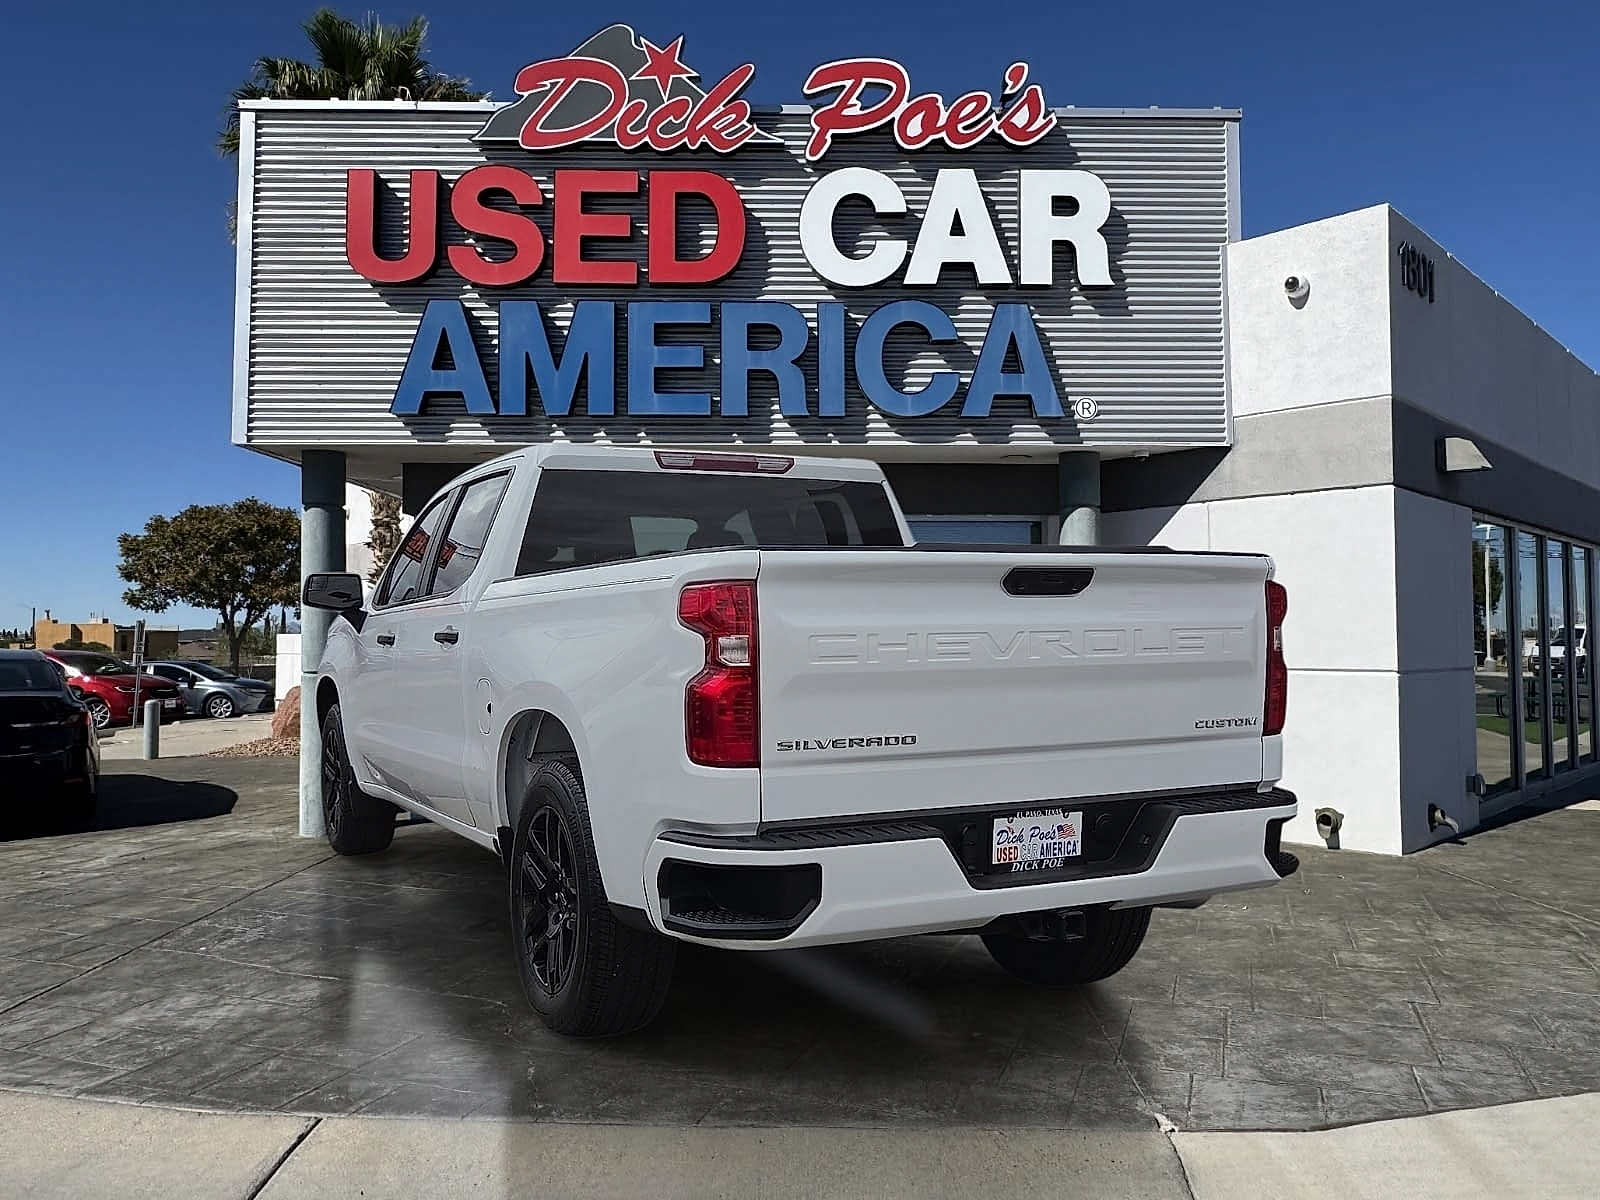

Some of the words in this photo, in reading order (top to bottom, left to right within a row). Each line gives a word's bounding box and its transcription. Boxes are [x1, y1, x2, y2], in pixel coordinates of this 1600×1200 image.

[513, 61, 757, 154] Dick
[802, 60, 1057, 162] Poe's
[346, 165, 746, 287] USED
[799, 167, 1114, 288] CAR
[390, 298, 1065, 420] AMERICA
[807, 625, 1248, 666] CHEVROLET
[1194, 717, 1258, 729] CUSTOM
[776, 735, 917, 752] SILVERADO
[996, 828, 1025, 845] Dick
[1028, 824, 1057, 843] Poe's
[996, 846, 1019, 862] USED
[1021, 843, 1038, 860] CAR
[1011, 861, 1039, 872] DICK
[1042, 858, 1064, 869] POE
